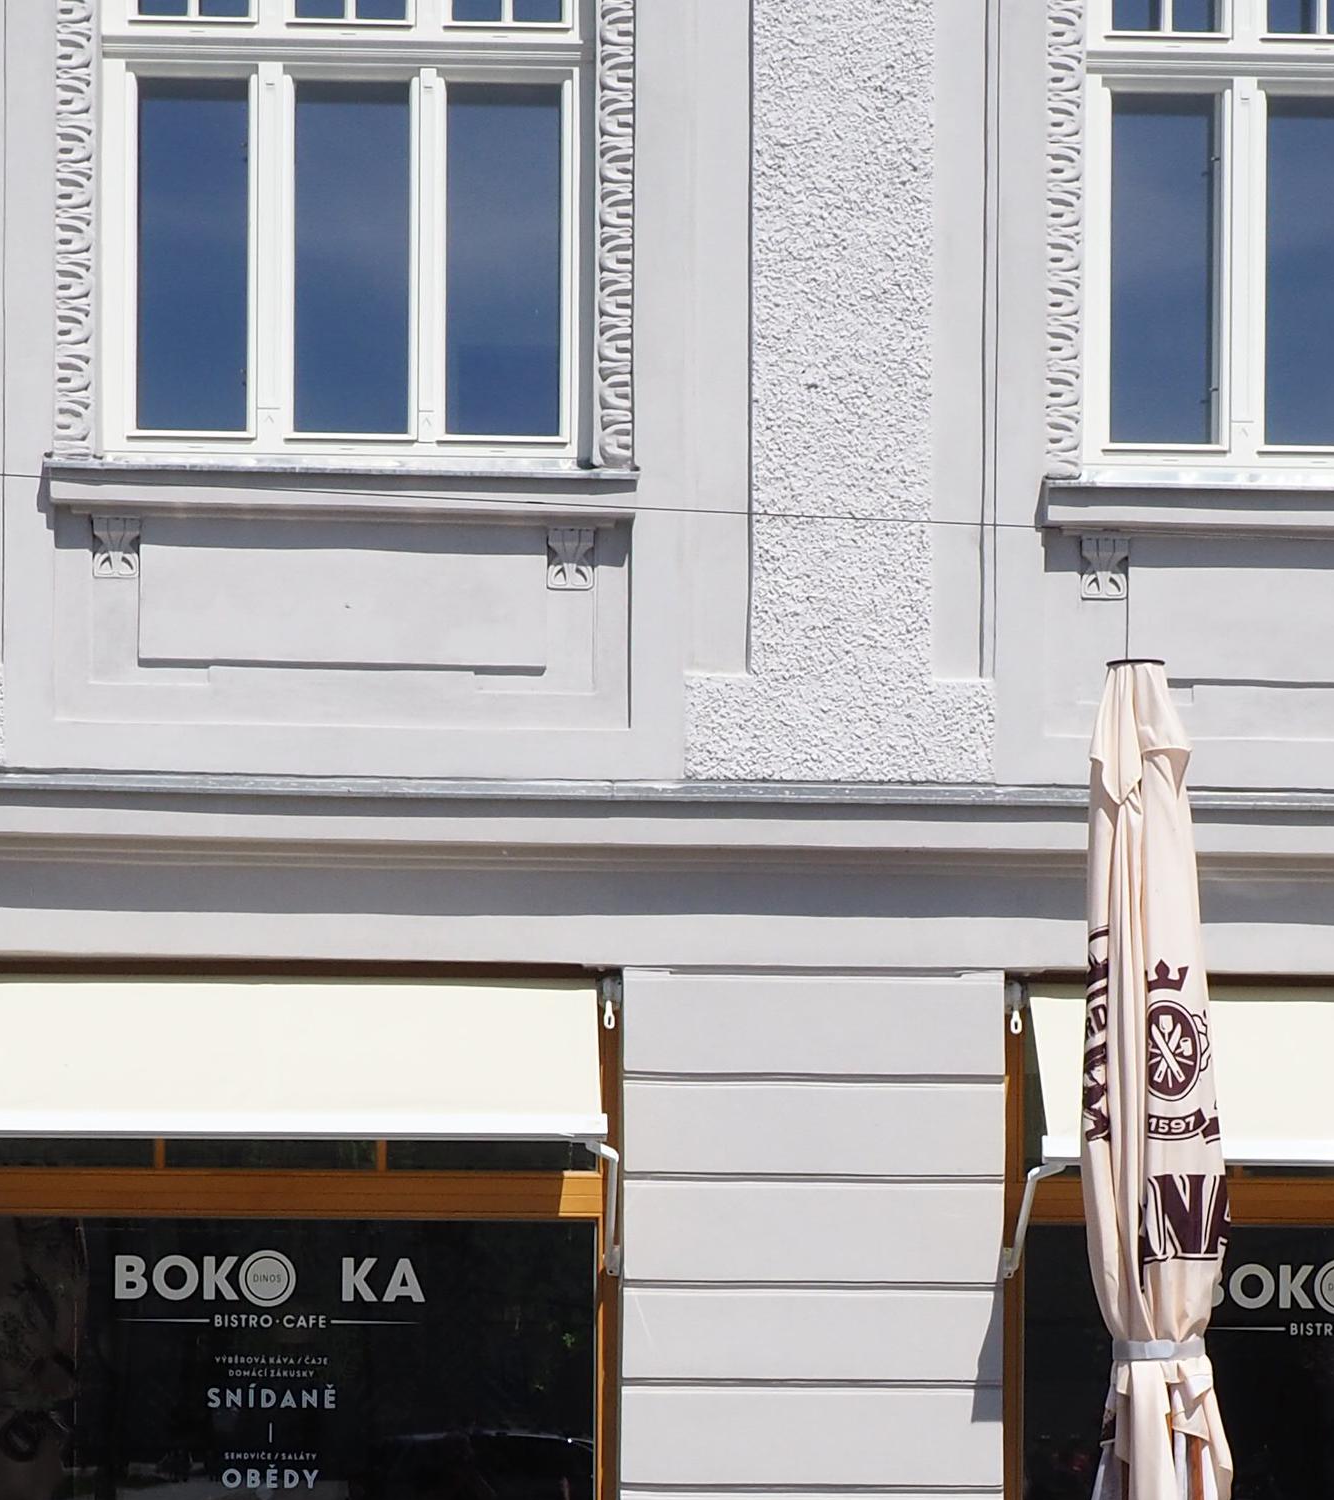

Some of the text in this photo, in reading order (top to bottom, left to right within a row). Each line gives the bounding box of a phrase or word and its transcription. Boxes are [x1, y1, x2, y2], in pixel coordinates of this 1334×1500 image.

[252, 1273, 282, 1283] DINOS
[214, 1314, 327, 1329] BISTRO CAFE
[207, 1383, 336, 1408] SNÍDANĚ
[222, 1464, 319, 1489] OBĚDY
